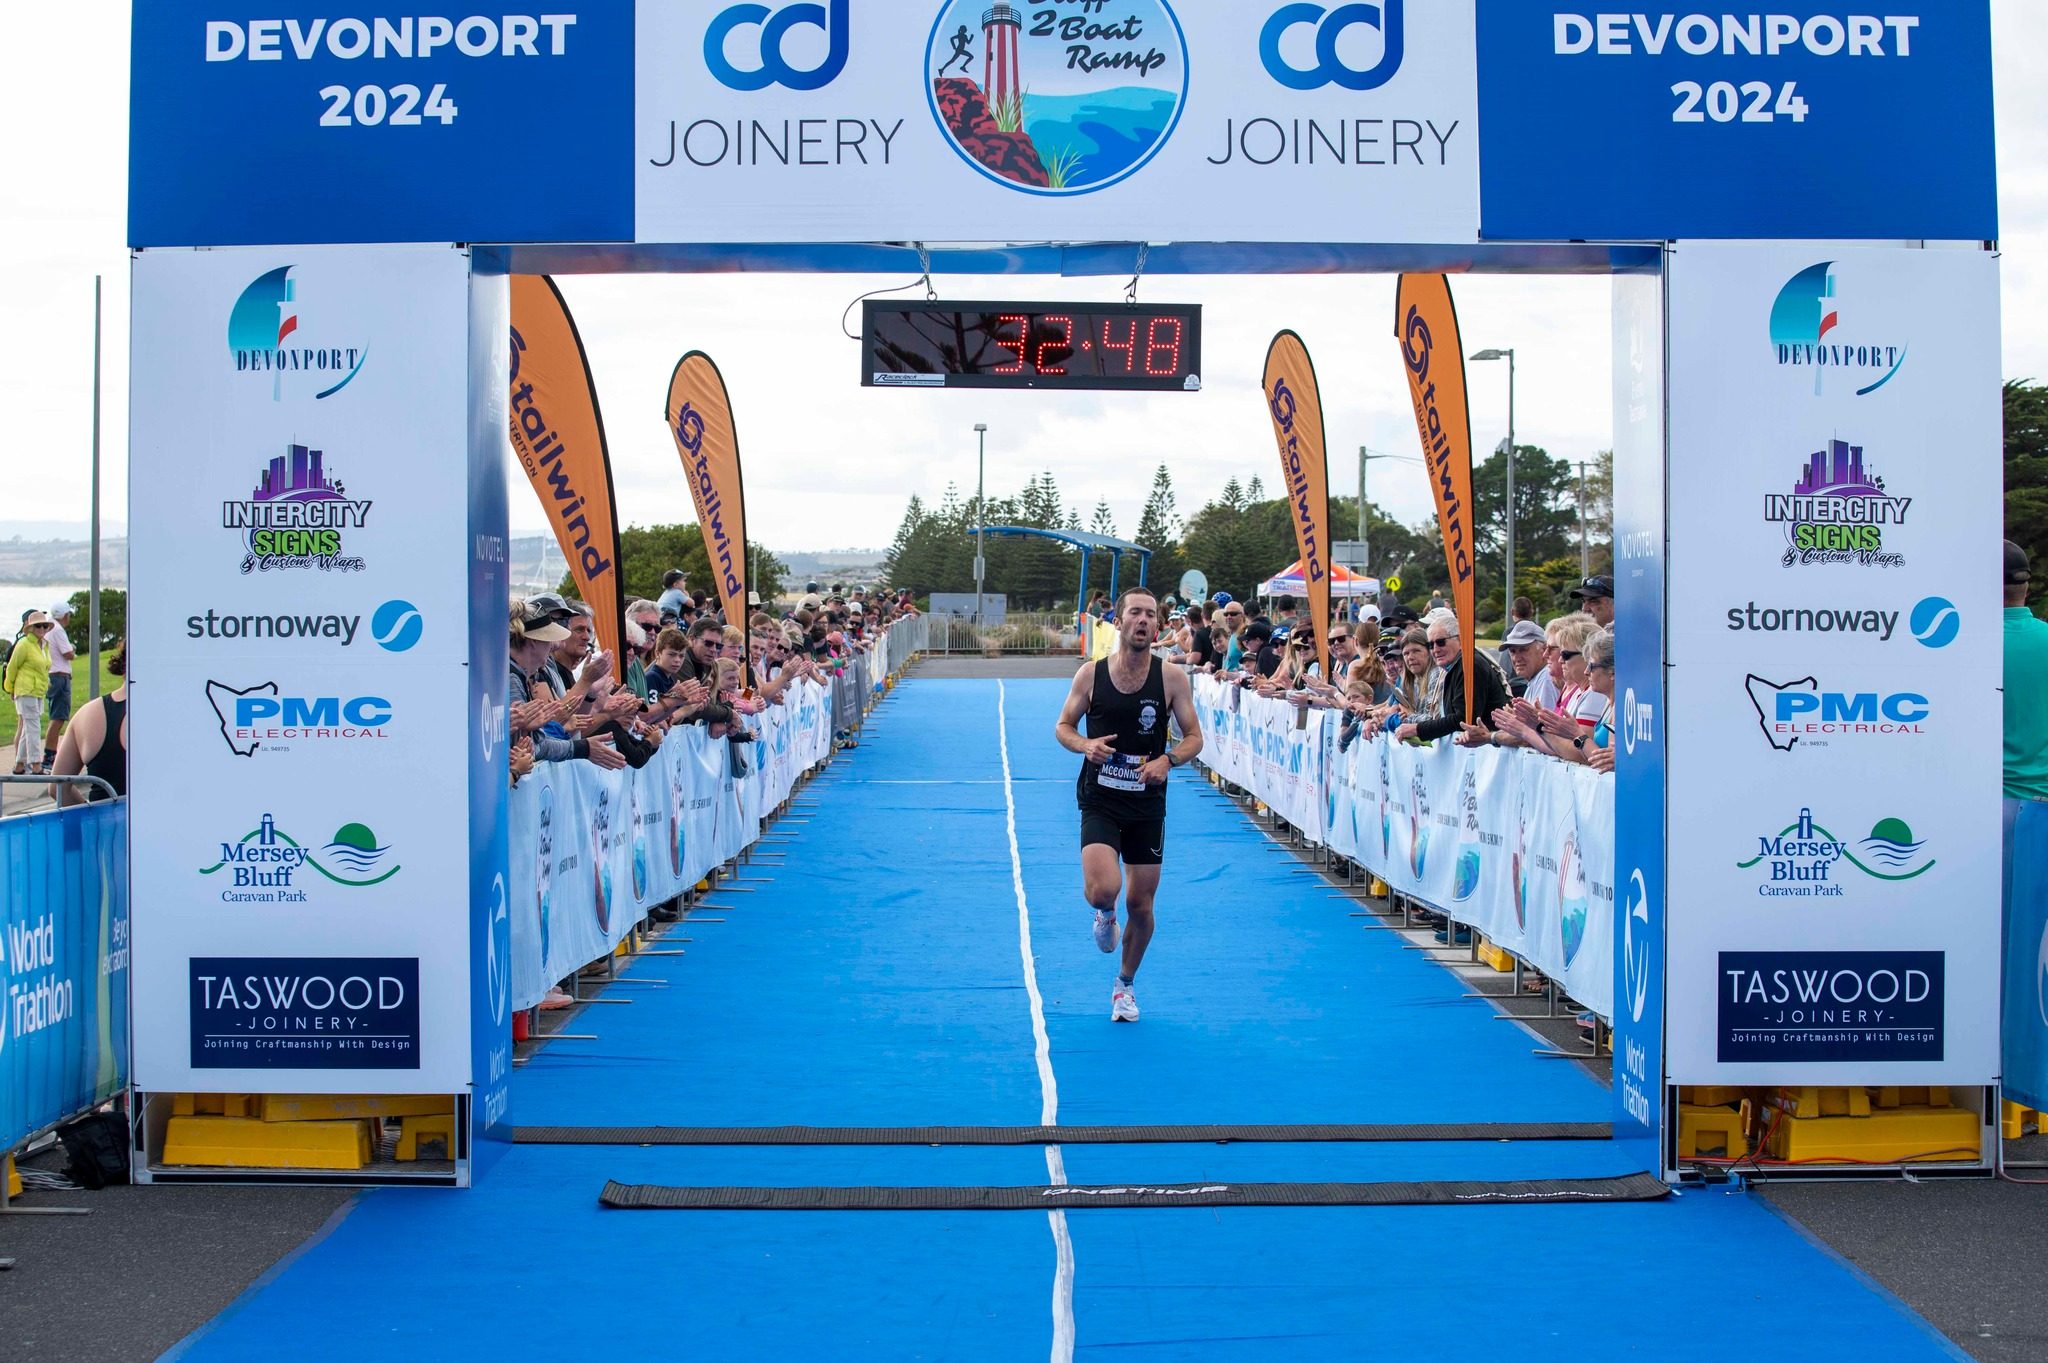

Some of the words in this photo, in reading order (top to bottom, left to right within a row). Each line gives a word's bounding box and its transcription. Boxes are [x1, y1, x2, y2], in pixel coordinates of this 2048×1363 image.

[205, 14, 577, 62] DEVONPORT
[1553, 14, 1919, 57] DEVONPORT
[1066, 45, 1166, 77] Ramp
[319, 84, 458, 126] 2024
[1670, 80, 1808, 123] 2024
[649, 118, 904, 167] JOINERY
[1207, 118, 1459, 165] JOINERY
[236, 348, 359, 371] DEVONPORT
[1778, 343, 1897, 368] DEVONPORT
[1416, 403, 1436, 477] NUTRITION
[511, 382, 611, 582] tailwind
[1423, 381, 1472, 583] tailwind
[223, 500, 372, 529] INTERCITY
[1287, 434, 1324, 583] tailwind
[1764, 494, 1912, 524] INTERCITY
[695, 454, 742, 599] tailwind
[1795, 524, 1882, 551] SIGNS
[253, 529, 341, 557] SIGNS
[1621, 530, 1654, 560] NOVOTEL
[1800, 547, 1852, 566] Custom
[1853, 548, 1905, 568] Wraps
[259, 551, 313, 571] Custom
[313, 551, 366, 571] Wraps
[187, 608, 360, 646] stornoway
[1727, 601, 1899, 641] stornoway
[236, 696, 392, 727] PMC
[1775, 692, 1929, 723] PMC
[236, 728, 388, 738] ELECTRICAL
[1775, 723, 1925, 734] ELECTRICAL
[221, 842, 309, 867] Mersey
[1758, 836, 1847, 861] Mersey
[233, 866, 294, 887] Bluff
[1770, 860, 1831, 881] Bluff
[221, 890, 274, 902] Caravan
[277, 890, 307, 902] Park
[1759, 884, 1811, 896] Caravan
[1814, 884, 1843, 896] Park
[8, 912, 54, 976] World
[198, 976, 404, 1010] TASWOOD
[1727, 969, 1930, 1003] TASWOOD
[10, 973, 72, 1039] Triathlon
[204, 1039, 249, 1050] Joining
[255, 1039, 332, 1050] Craftmanship
[339, 1040, 364, 1049] With
[371, 1040, 411, 1050] Design
[1731, 1033, 1776, 1043] Joining
[1783, 1033, 1859, 1043] Craftmanship
[1866, 1033, 1890, 1042] With
[1898, 1033, 1935, 1042] Design
[1625, 1034, 1645, 1082] World
[1622, 1072, 1649, 1128] Triathlon
